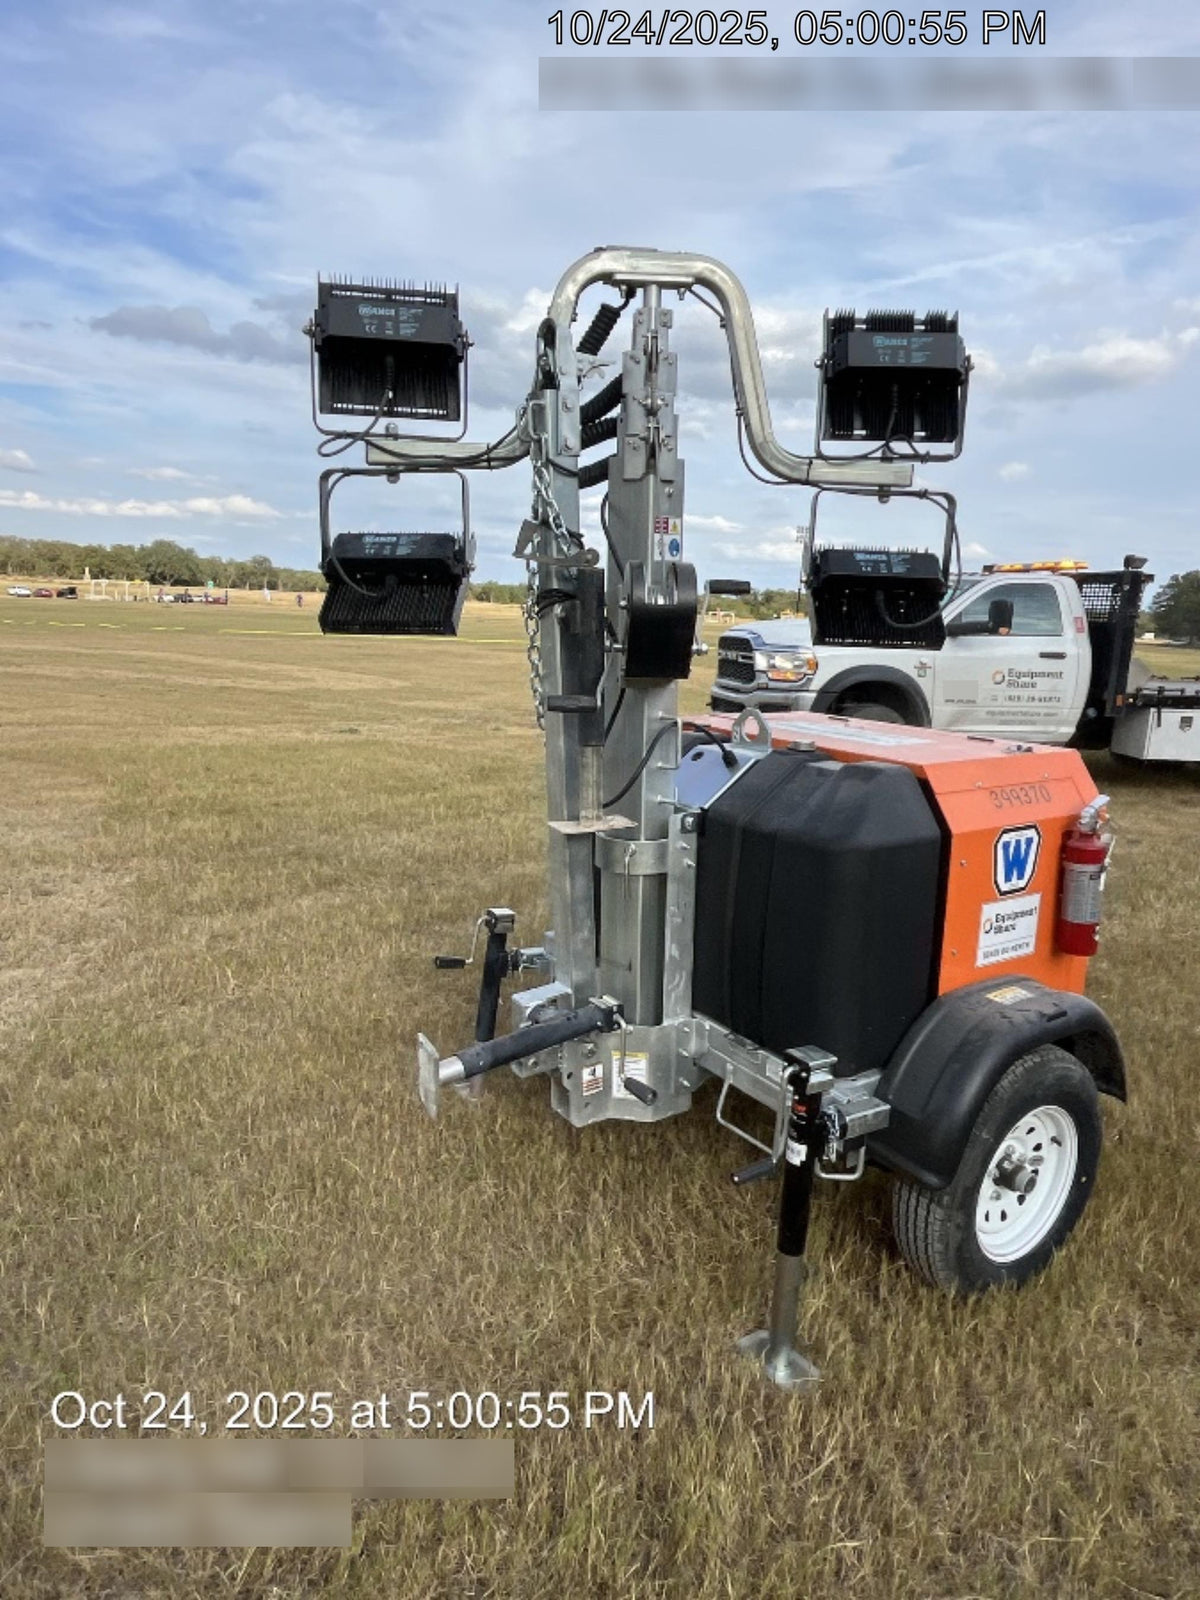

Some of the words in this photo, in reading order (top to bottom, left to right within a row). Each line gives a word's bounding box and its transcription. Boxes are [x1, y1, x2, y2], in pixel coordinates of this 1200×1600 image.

[1007, 668, 1063, 681] Equipment
[989, 784, 1052, 809] 399370
[1002, 836, 1035, 885] W
